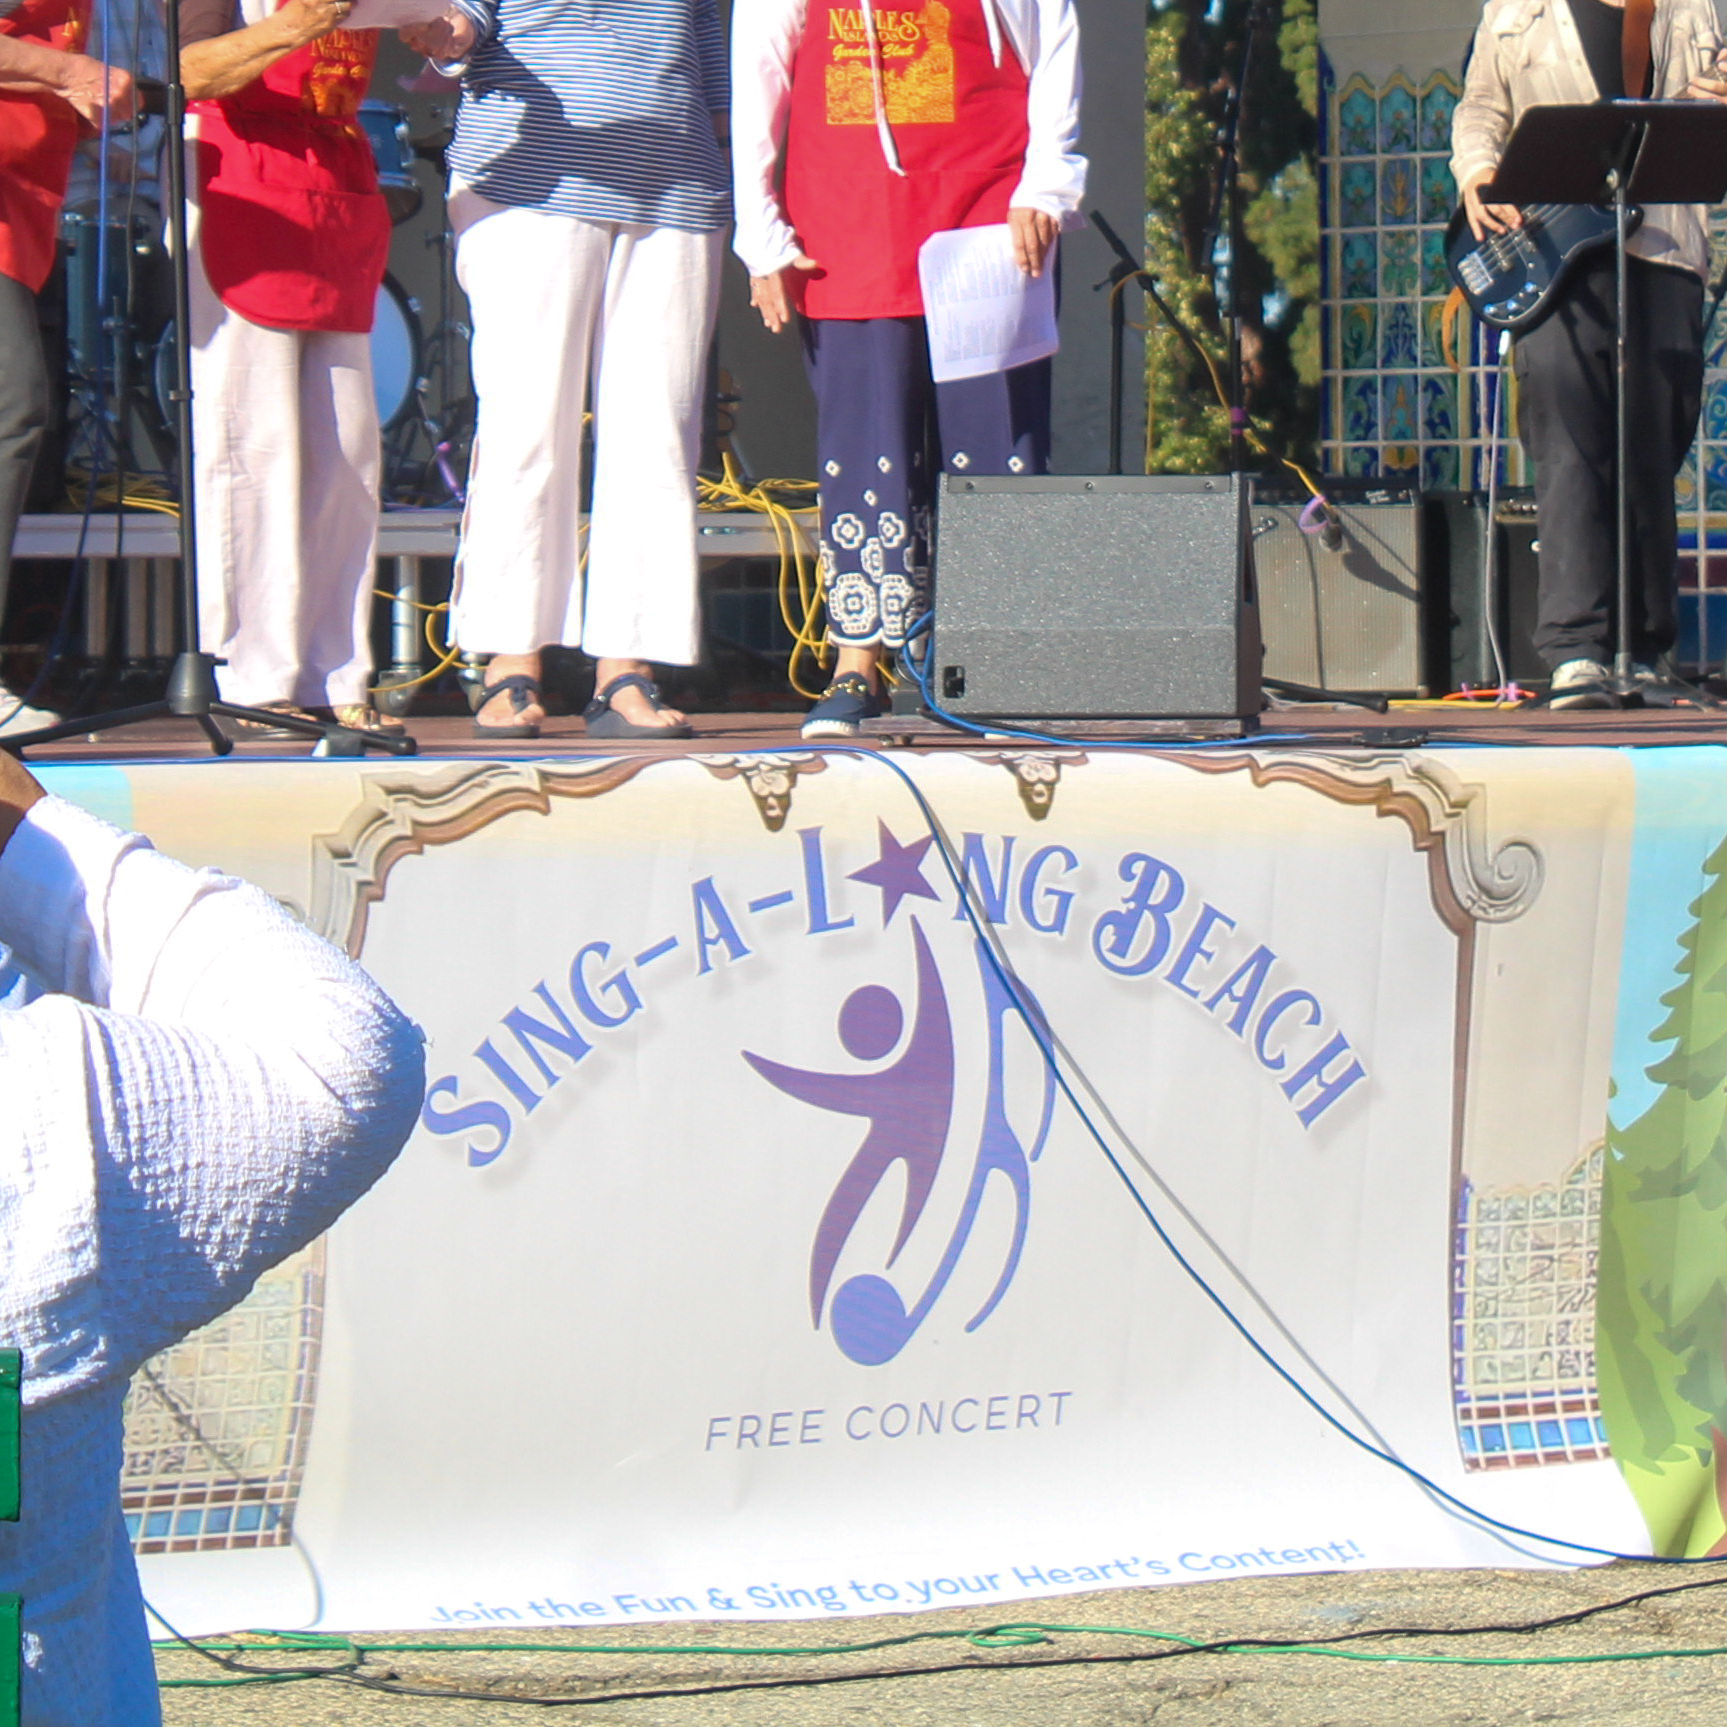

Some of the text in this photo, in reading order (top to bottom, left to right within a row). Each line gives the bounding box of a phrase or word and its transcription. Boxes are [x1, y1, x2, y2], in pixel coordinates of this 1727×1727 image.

[842, 31, 900, 43] ISLDS
[882, 42, 915, 59] Club
[1092, 851, 1367, 1131] BEACH
[704, 1391, 1074, 1452] FREE CONCERT
[429, 1541, 1367, 1623] Join the Fun & Sing to your Heart's Content!
